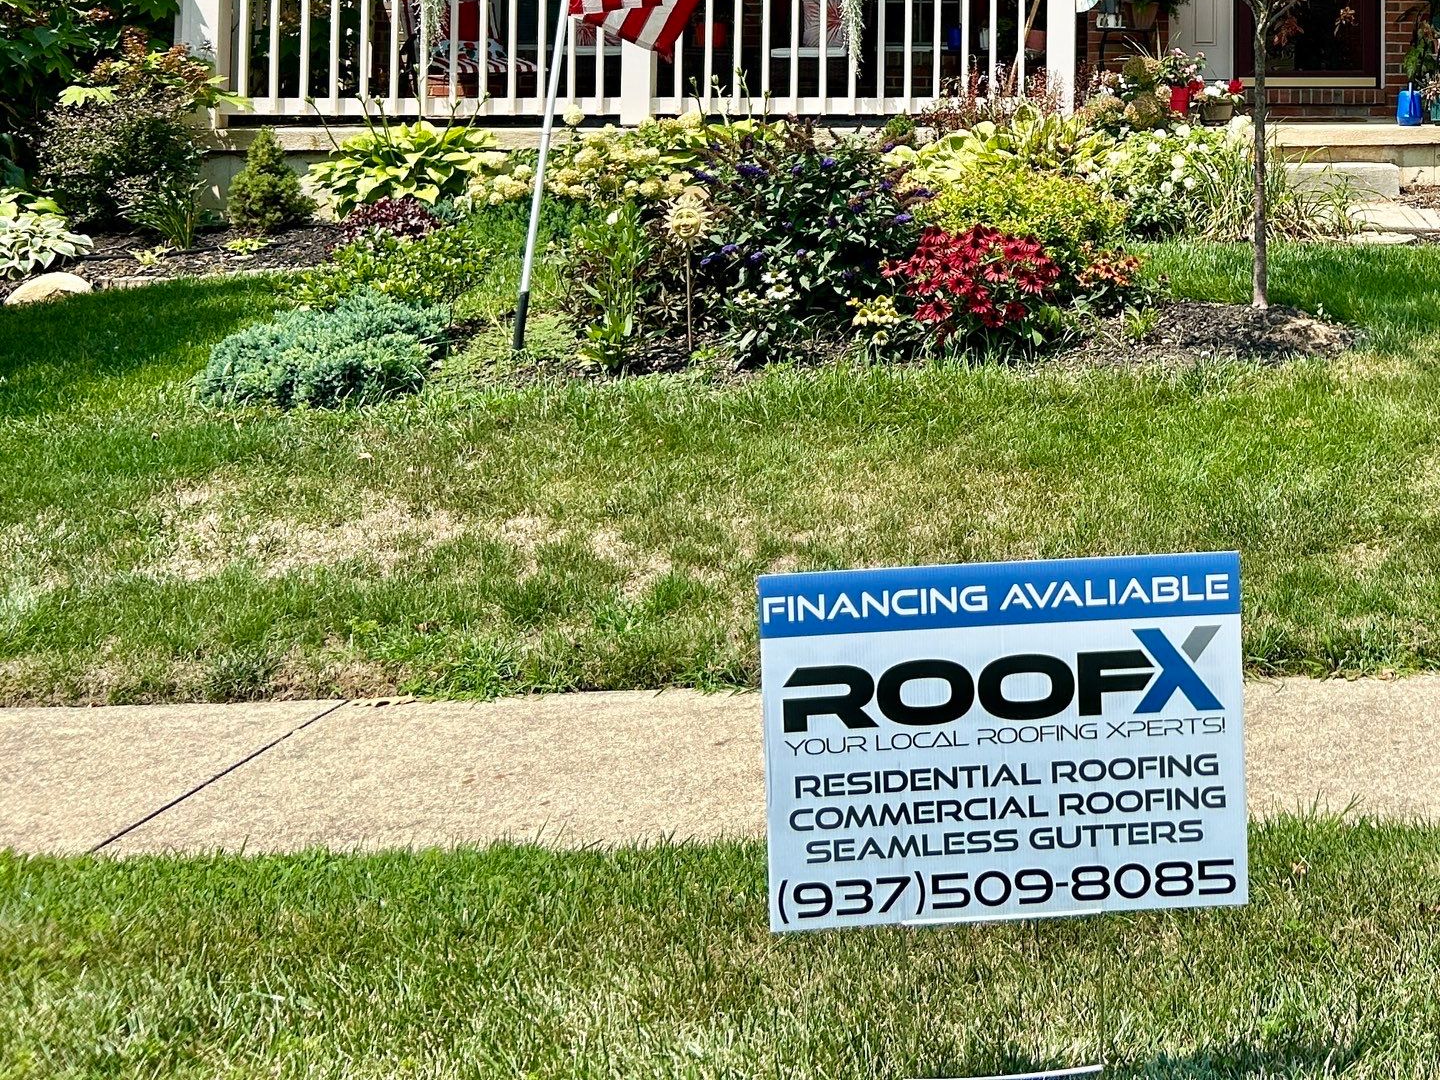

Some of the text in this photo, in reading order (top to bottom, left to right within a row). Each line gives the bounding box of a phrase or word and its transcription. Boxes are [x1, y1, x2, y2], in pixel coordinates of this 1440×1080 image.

[762, 573, 1229, 623] FINANCING AVALIABLE
[782, 624, 1226, 733] ROOFX
[784, 716, 1226, 756] YOUR LOCAL ROOFING XPERTS!
[794, 753, 1219, 799] RESIDENTIAL ROOFING
[789, 786, 1227, 831] COMMERCIAL ROOFING
[805, 819, 1204, 864] SEAMLESS GUTTERS
[777, 858, 1237, 925] (937)509-8085
